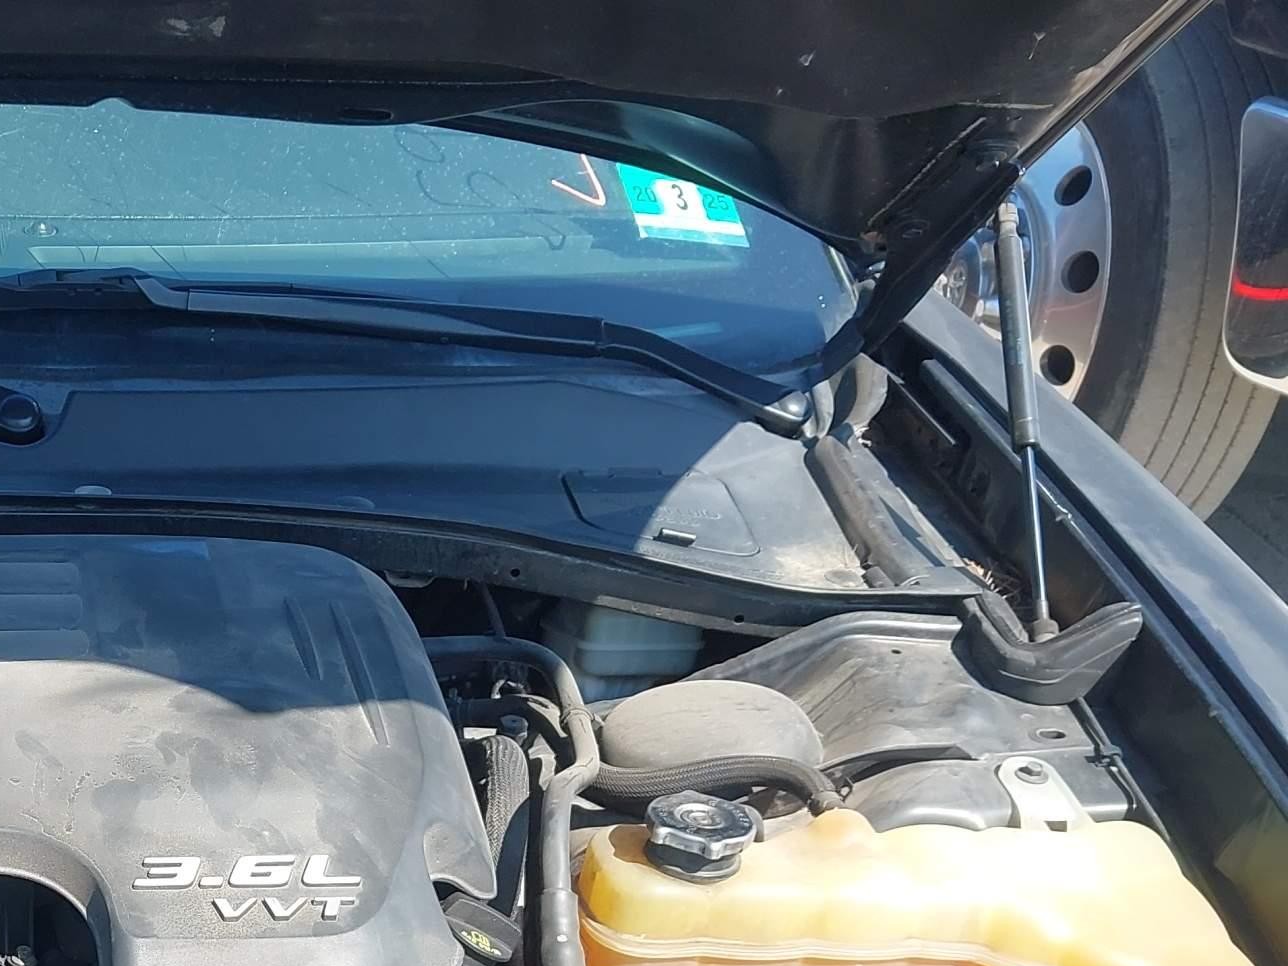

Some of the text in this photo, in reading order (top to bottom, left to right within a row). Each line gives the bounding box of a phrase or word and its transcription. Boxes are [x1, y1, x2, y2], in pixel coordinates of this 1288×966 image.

[671, 183, 688, 210] 3
[703, 193, 729, 210] 25
[132, 855, 361, 890] 3.6L
[212, 896, 356, 922] VVT
